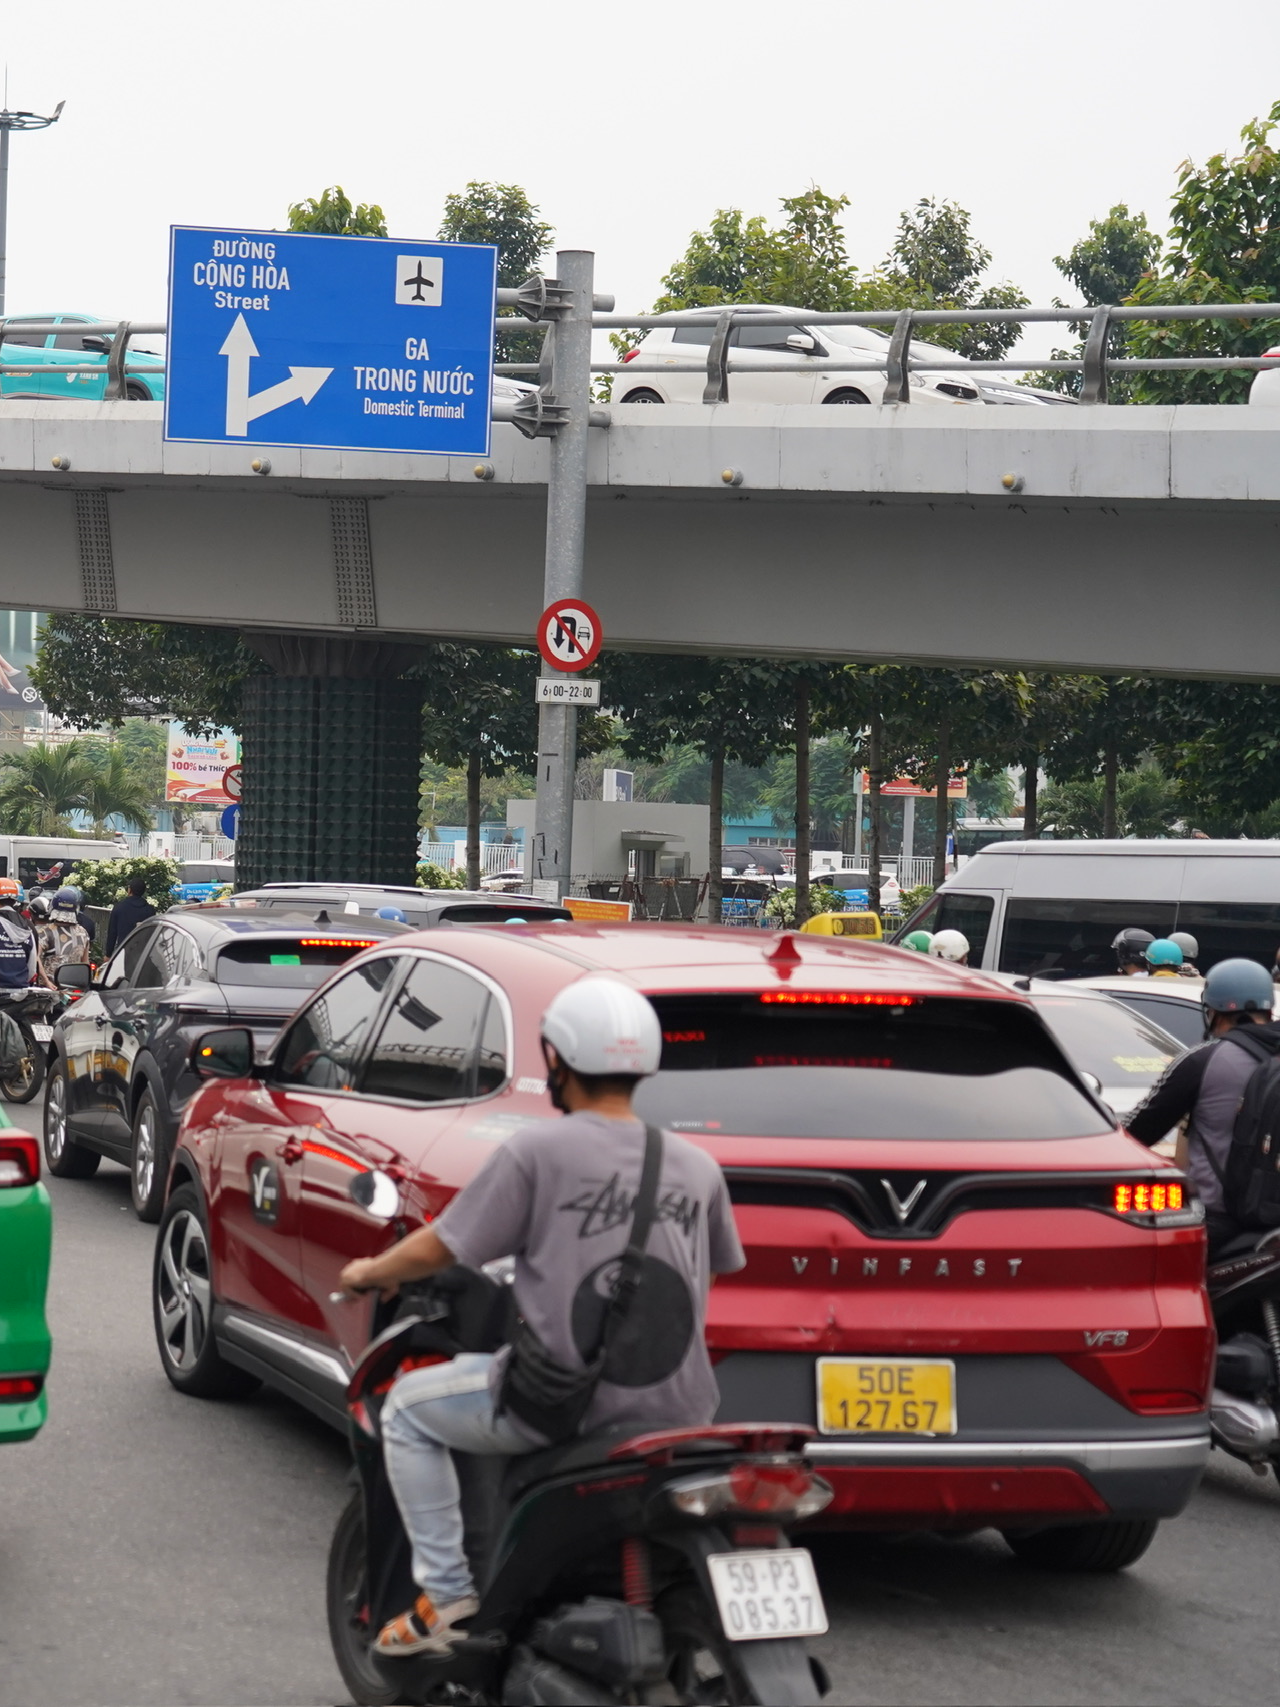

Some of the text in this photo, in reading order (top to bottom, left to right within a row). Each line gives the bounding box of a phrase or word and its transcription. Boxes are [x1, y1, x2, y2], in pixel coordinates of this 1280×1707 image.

[212, 237, 276, 260] ĐƯỜNG
[193, 258, 291, 291] CỘNG HÒA
[214, 291, 270, 311] Street
[405, 337, 430, 361] GA
[354, 366, 474, 395] TRONG NƯỚC
[363, 398, 465, 419] Domestic Terminal
[543, 685, 593, 698] 6:00-22:00
[171, 761, 197, 771] 100%
[791, 1256, 1023, 1277] VINFAST
[1083, 1330, 1130, 1347] VF8
[858, 1367, 915, 1396] 50E
[839, 1400, 939, 1430] 127.67
[727, 1596, 813, 1633] 085.37
